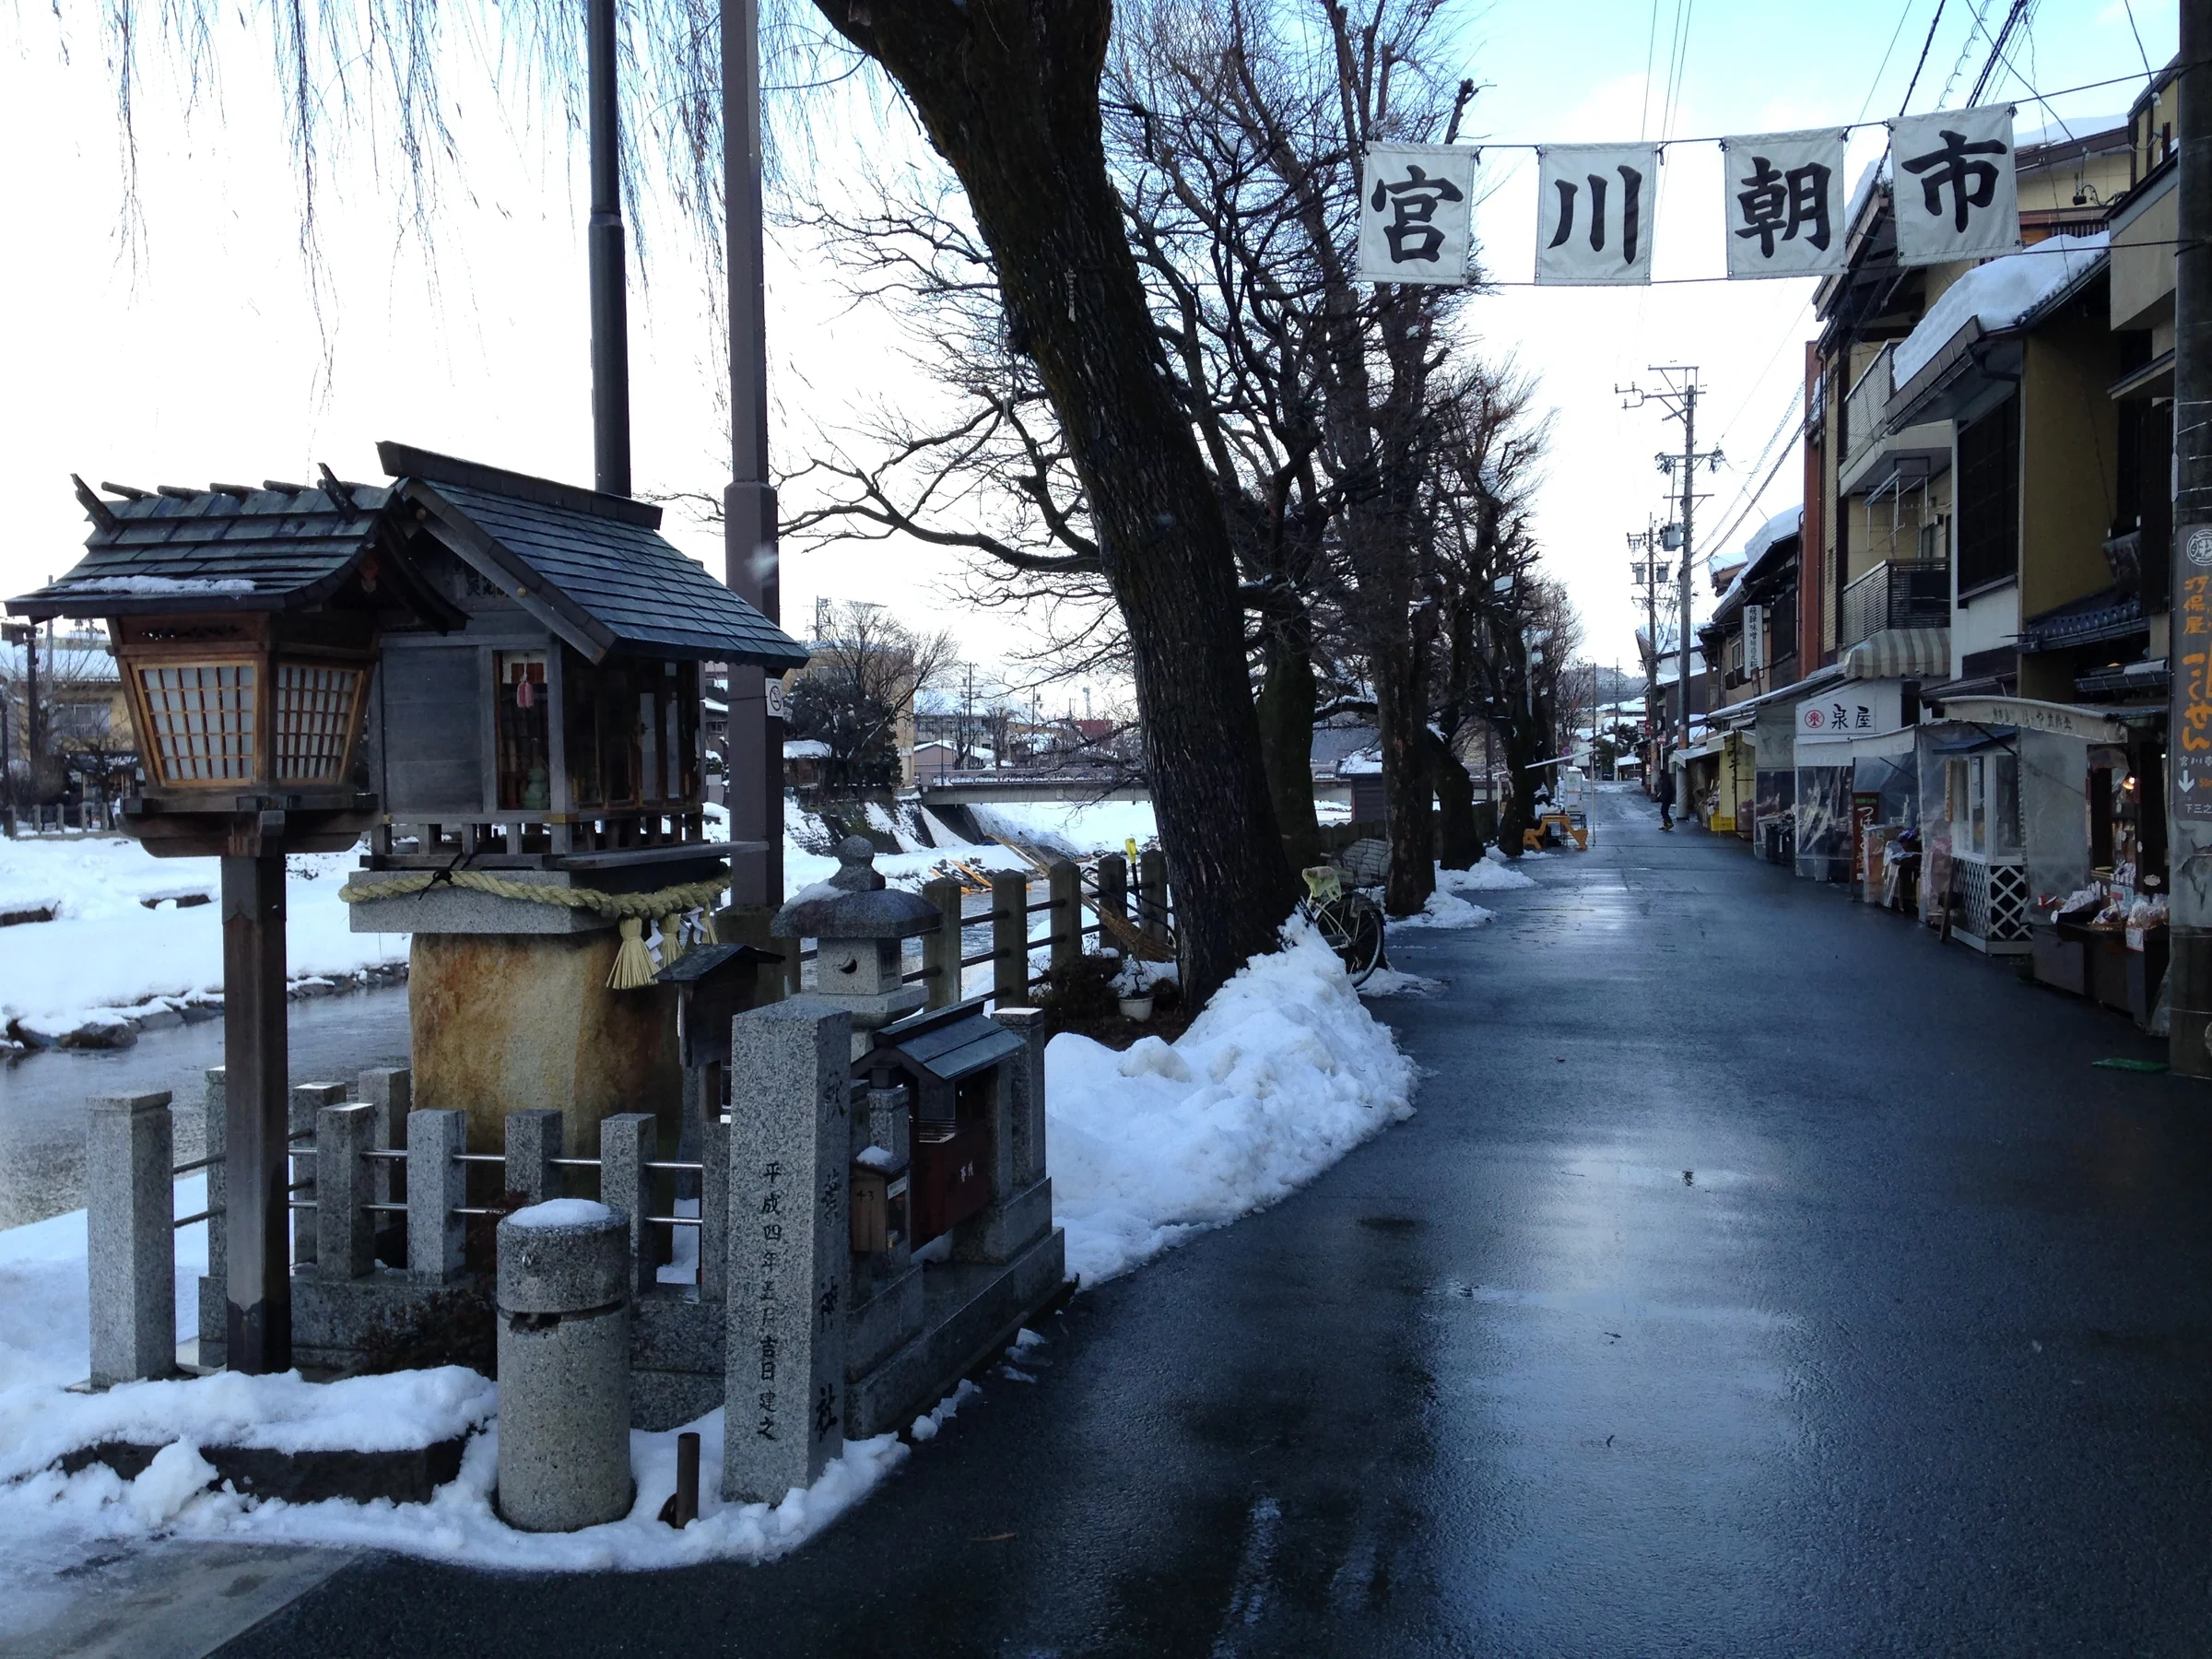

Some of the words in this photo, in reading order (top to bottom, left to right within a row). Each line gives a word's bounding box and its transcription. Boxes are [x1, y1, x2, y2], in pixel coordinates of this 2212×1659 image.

[1371, 129, 2008, 266] 宮川朝市
[1831, 703, 1872, 729] 泉屋
[855, 1189, 875, 1202] 43
